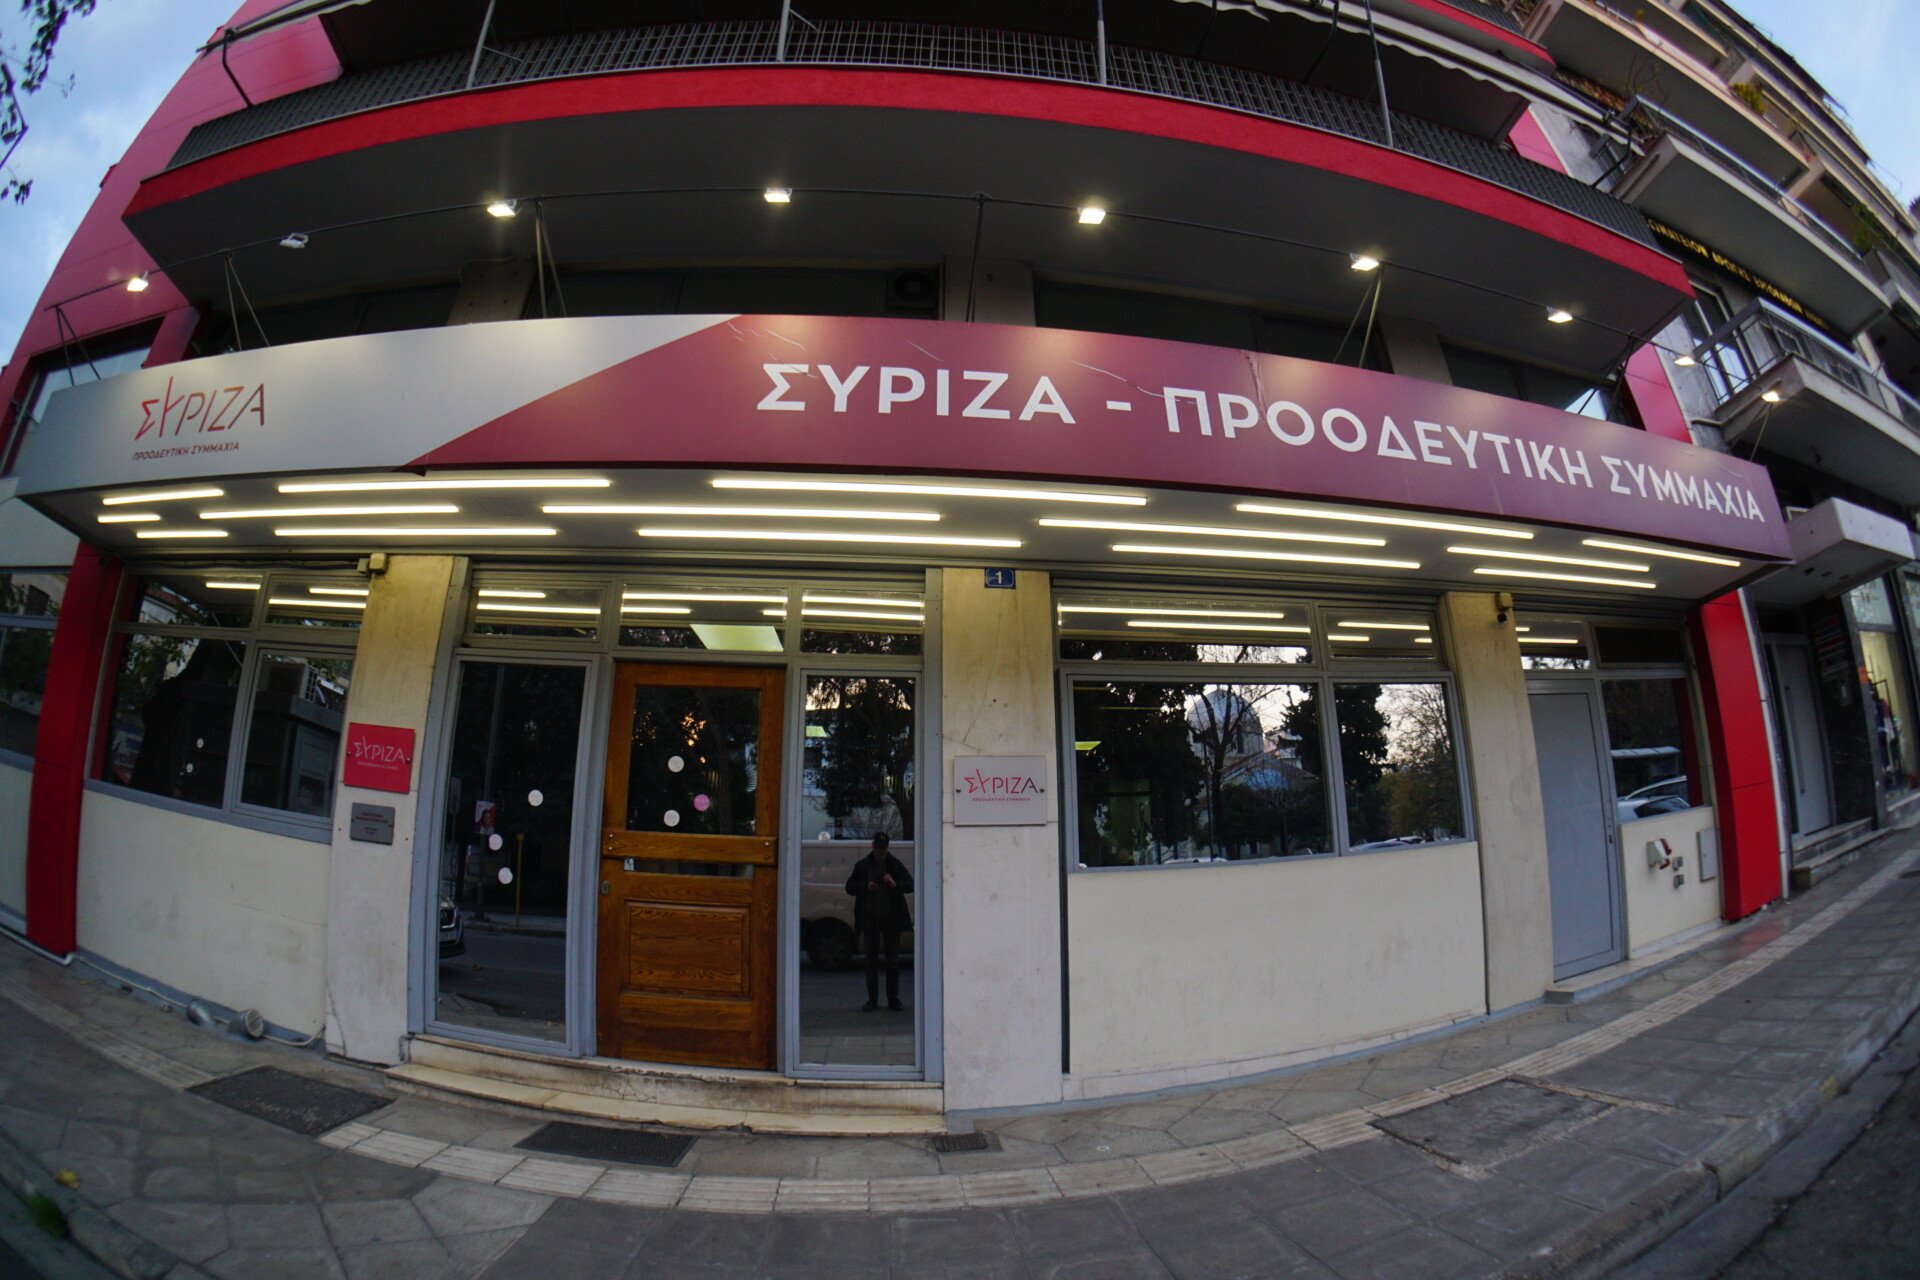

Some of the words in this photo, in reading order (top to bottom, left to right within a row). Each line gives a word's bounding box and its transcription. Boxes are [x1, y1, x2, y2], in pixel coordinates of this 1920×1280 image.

[134, 376, 265, 441] ΣΥΡΙΖΑ
[132, 447, 190, 461] ΠΡΟΟΔΕΥΤΙΚΗ
[191, 441, 239, 455] ΣΥΜΜΑΧΙΑ
[757, 363, 1076, 425] ΣΥΡΙΖΑ
[1163, 386, 1594, 489] ΠΡΟΟΔΕΥΤΙΚΗ
[1601, 455, 1766, 523] ΣΥΜΜΑΧΙΑ
[995, 570, 1002, 585] 1
[353, 735, 406, 764] ΣΥΡΙΖΑ
[964, 768, 1039, 794] ΣΥΡΙΖΑ
